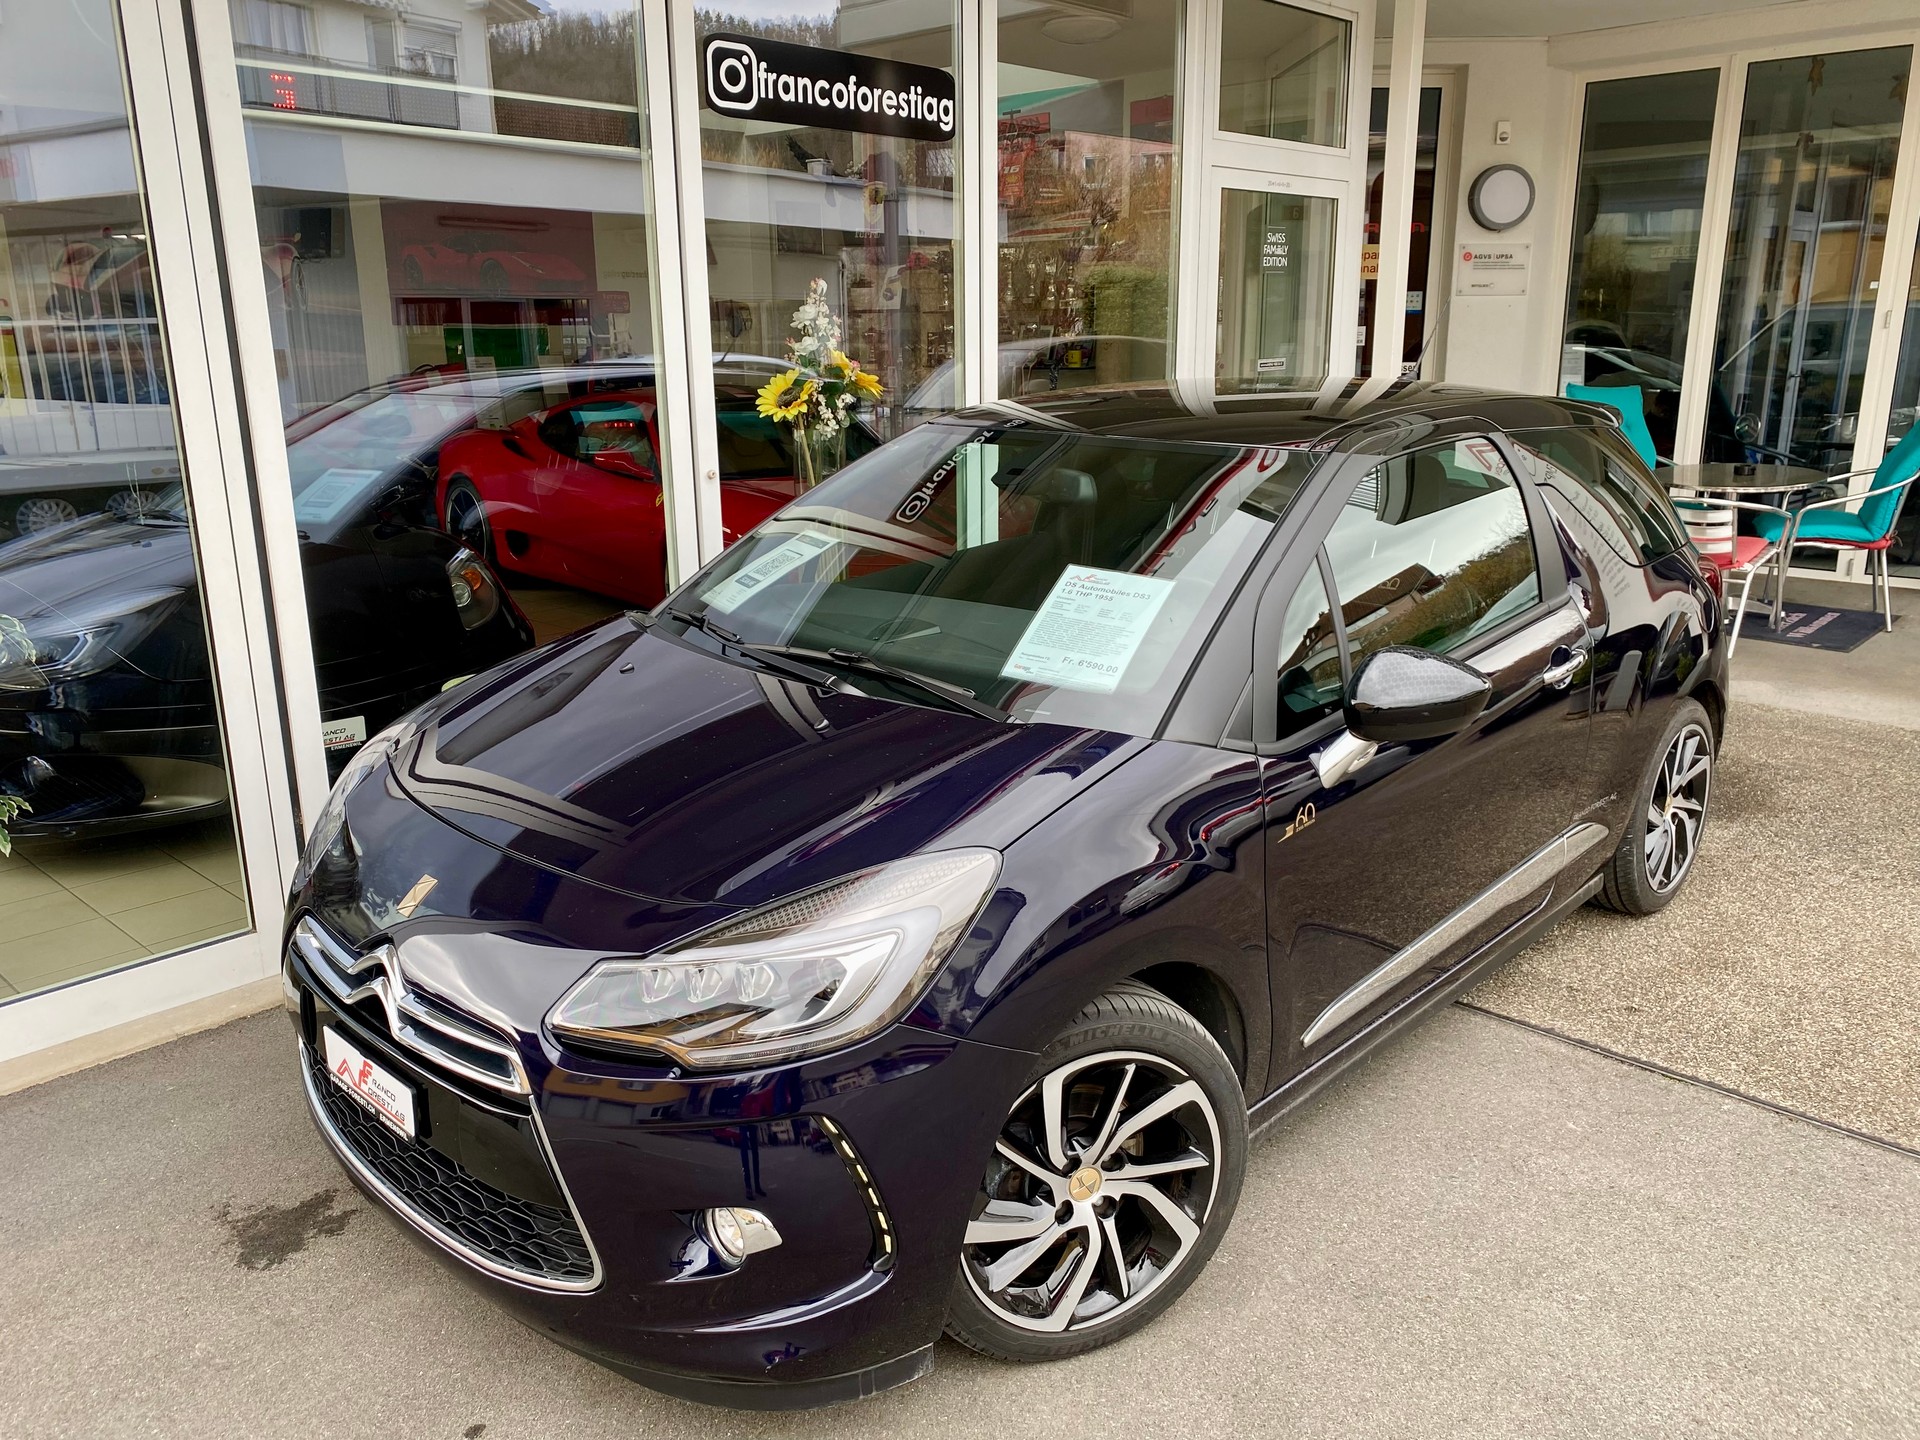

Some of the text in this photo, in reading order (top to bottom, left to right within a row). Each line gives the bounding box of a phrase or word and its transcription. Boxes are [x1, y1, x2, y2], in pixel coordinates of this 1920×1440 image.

[758, 61, 954, 132] francoforestiag
[1267, 232, 1286, 243] SWISS
[1263, 256, 1288, 267] EDITION
[1079, 582, 1131, 597] Automobiles
[1132, 592, 1152, 600] DS3
[1062, 656, 1075, 665] Fr.
[1078, 660, 1118, 674] 6'590.00
[1069, 1022, 1167, 1048] MICHELIN
